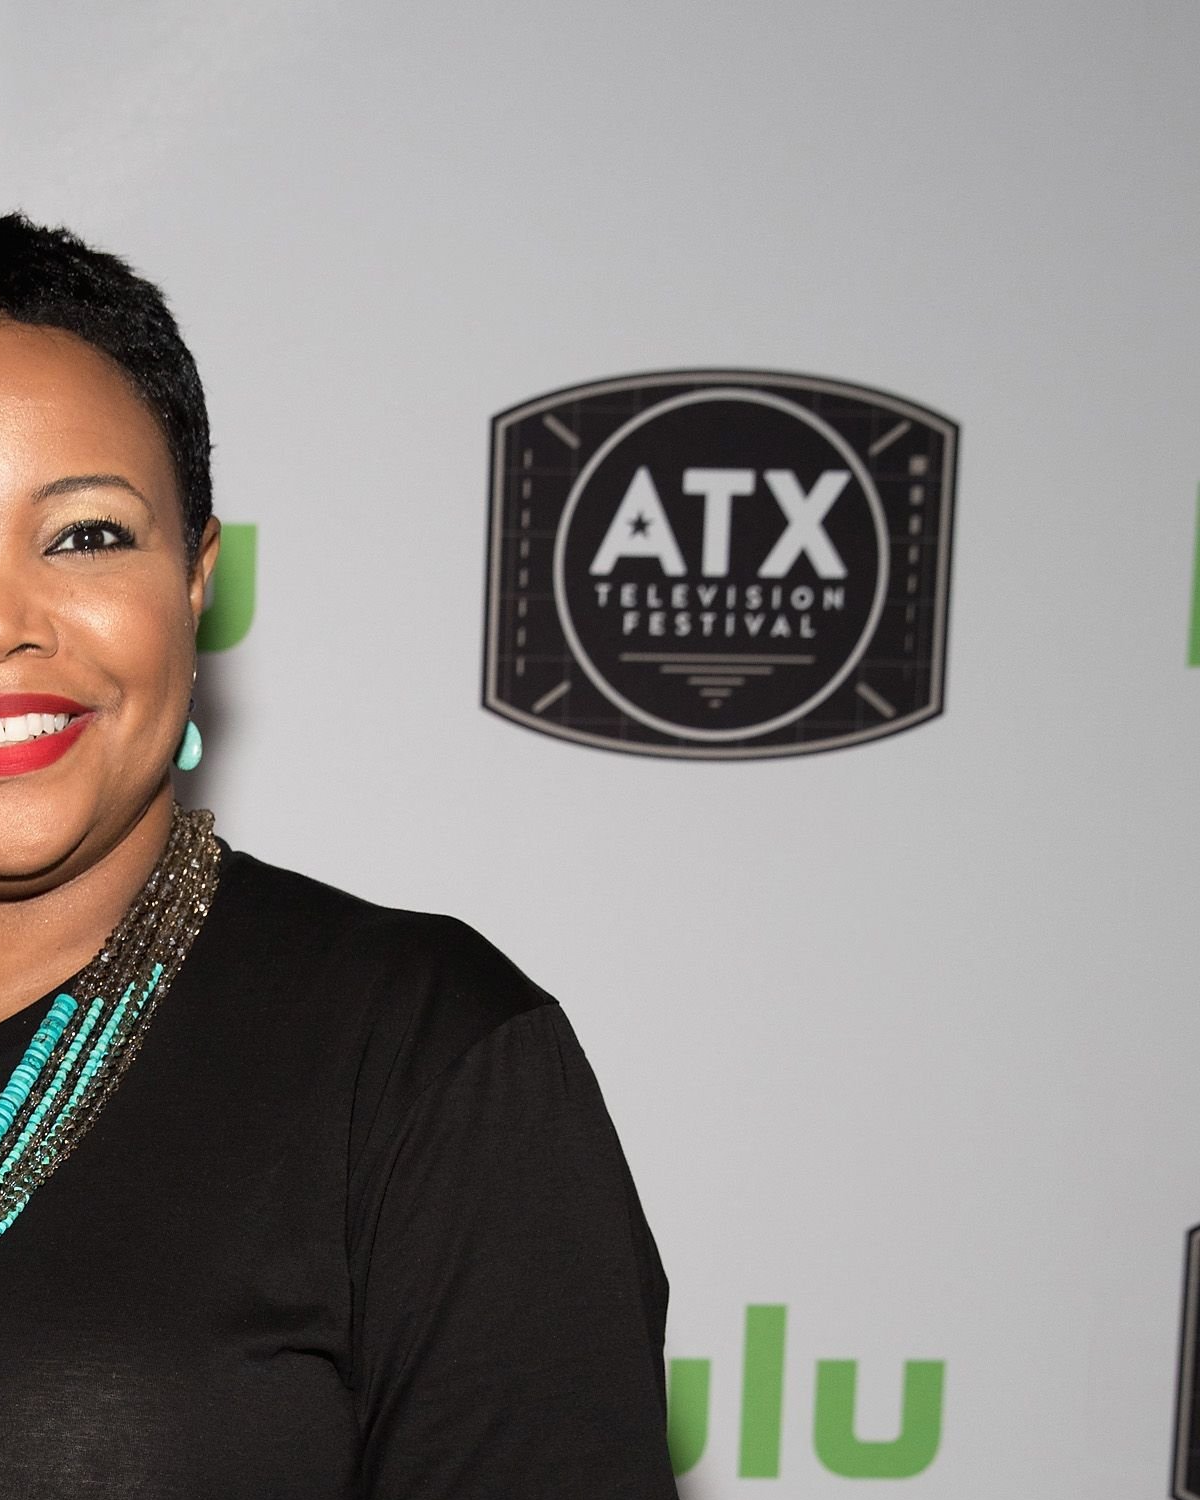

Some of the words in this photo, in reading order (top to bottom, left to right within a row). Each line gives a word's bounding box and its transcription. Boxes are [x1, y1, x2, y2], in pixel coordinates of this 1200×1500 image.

[589, 465, 852, 579] ATX
[594, 582, 846, 611] TELEVISION
[622, 611, 817, 639] FESTIVAL
[667, 1303, 946, 1480] lu
